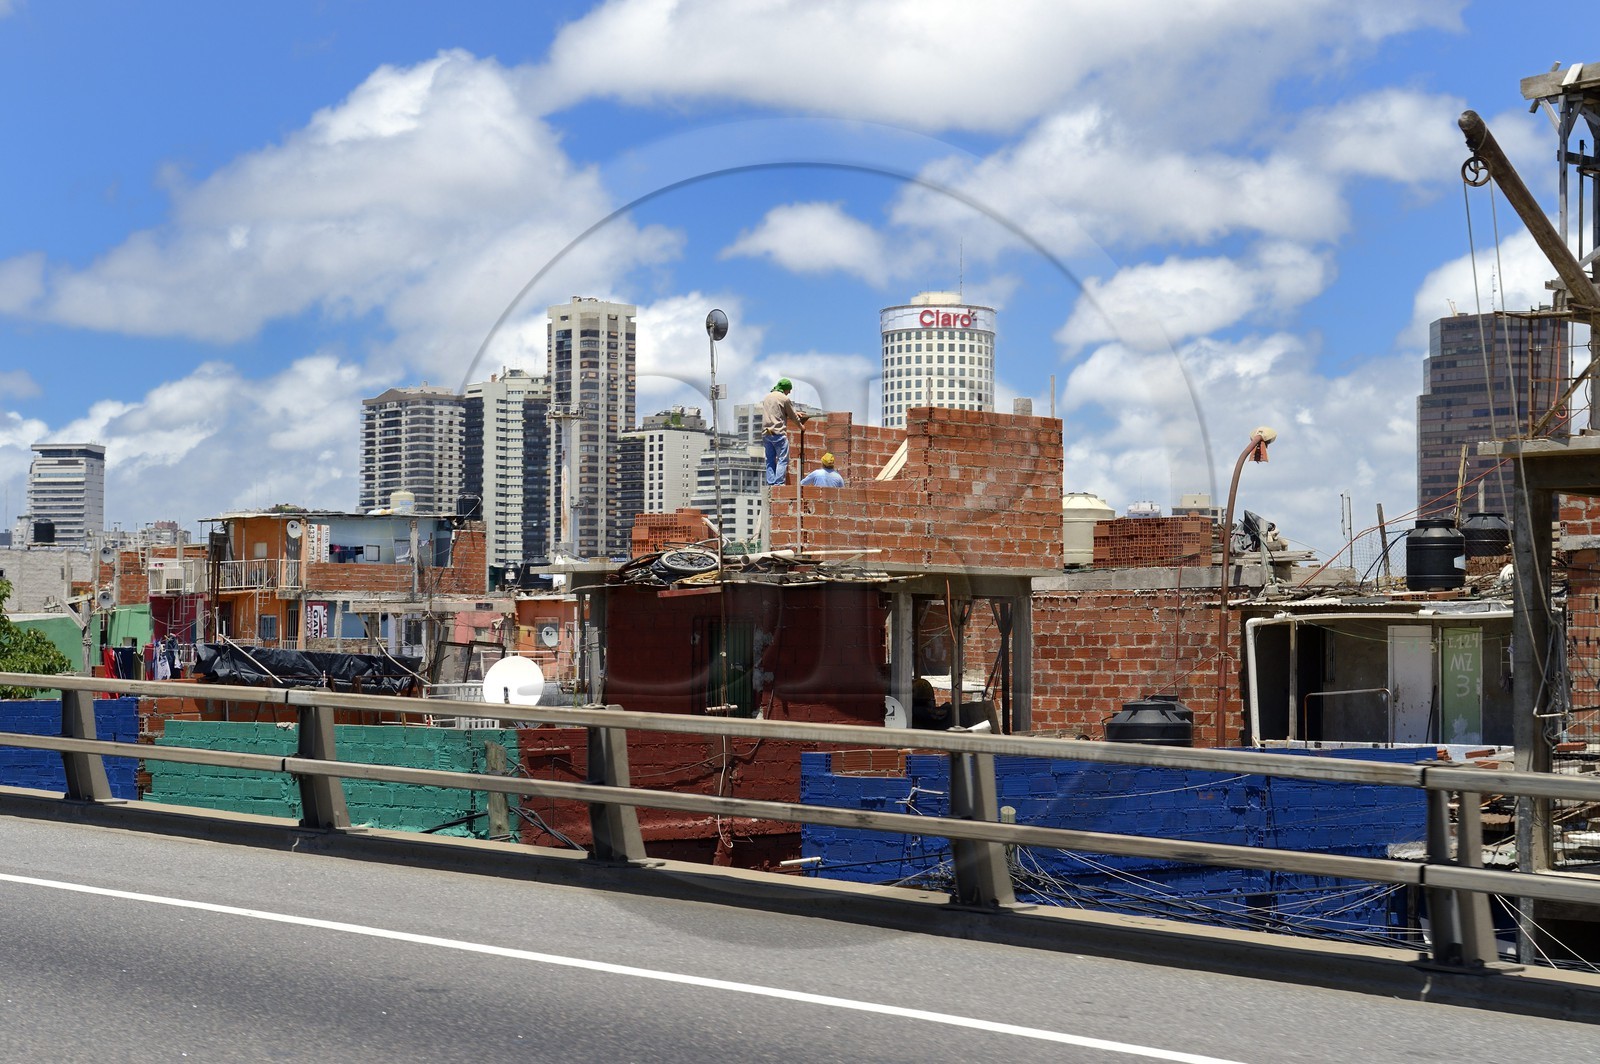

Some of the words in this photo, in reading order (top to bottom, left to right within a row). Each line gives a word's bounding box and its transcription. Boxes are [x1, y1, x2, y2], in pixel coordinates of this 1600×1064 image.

[919, 309, 972, 328] Claro
[1450, 653, 1474, 672] MZ
[1456, 674, 1470, 697] 3
